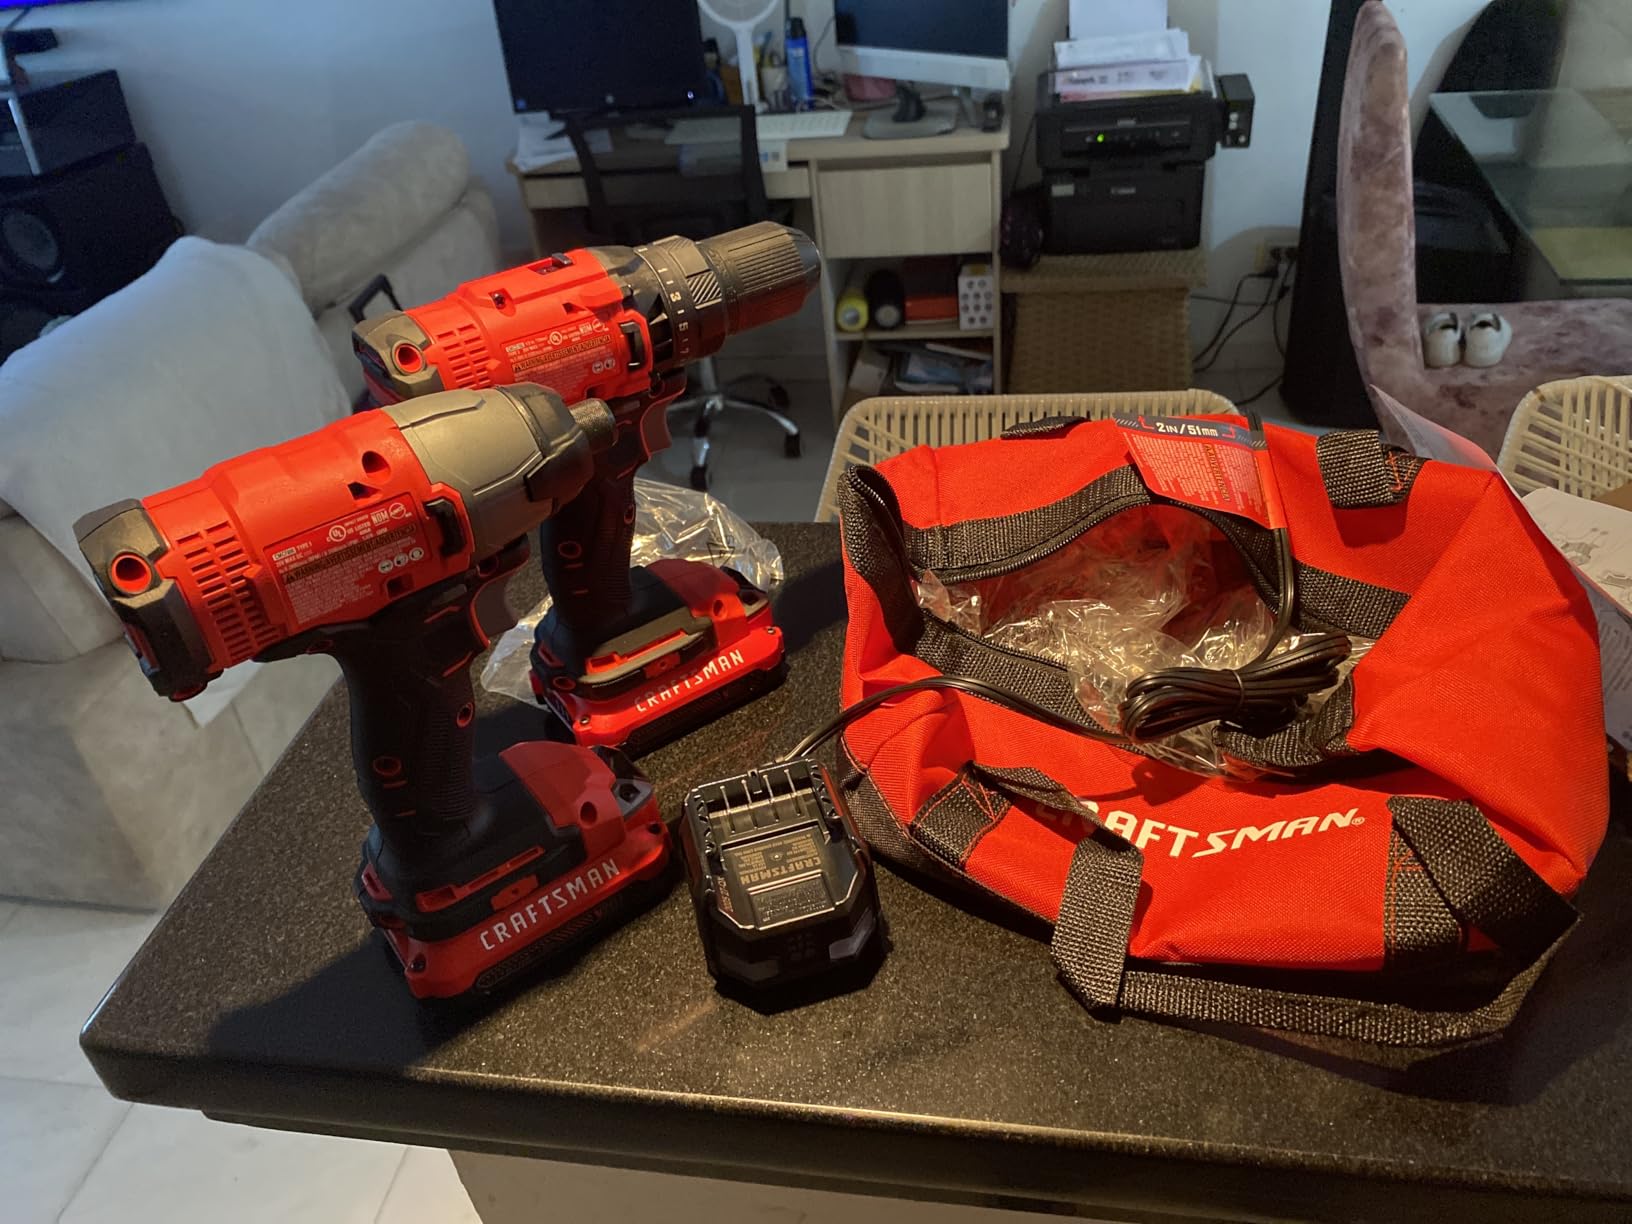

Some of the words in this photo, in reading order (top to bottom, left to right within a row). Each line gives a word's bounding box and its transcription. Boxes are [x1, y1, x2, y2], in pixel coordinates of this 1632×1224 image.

[669, 291, 682, 302] 3
[678, 322, 689, 331] 5
[371, 510, 389, 525] NOM
[635, 649, 745, 713] CRAFTSMAN
[740, 856, 821, 885] CRAFTSMAN
[480, 858, 621, 951] CRAFTSMAN
